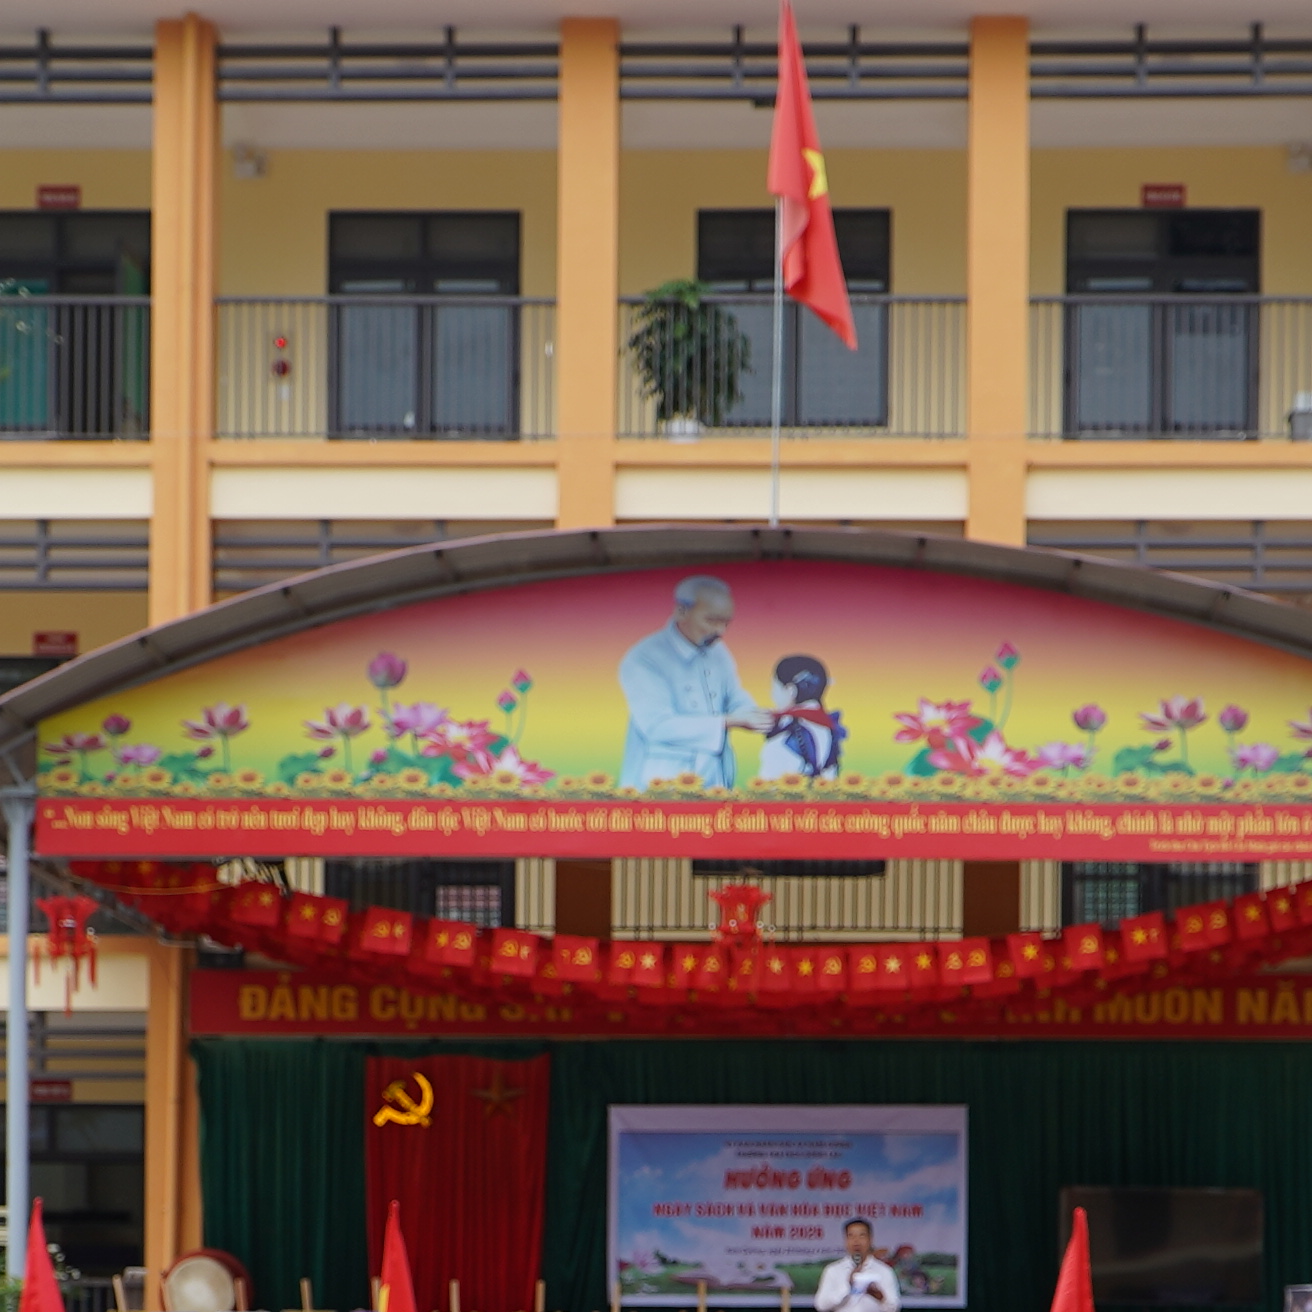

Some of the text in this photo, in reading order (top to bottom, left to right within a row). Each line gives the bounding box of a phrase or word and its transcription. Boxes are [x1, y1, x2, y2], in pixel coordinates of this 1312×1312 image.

[129, 804, 160, 835] Việt
[161, 804, 196, 829] Nam
[329, 805, 354, 836] hay
[408, 805, 436, 830] dân
[461, 805, 491, 836] Việt
[492, 806, 528, 831] Nam
[667, 813, 714, 838] quang
[734, 807, 768, 832] sánh
[819, 807, 844, 833] các
[928, 810, 961, 834] năm
[1037, 809, 1063, 840] hay
[239, 973, 359, 1021] ĐẢNG
[723, 1162, 852, 1189] HƯỞNG ỨNG
[855, 1201, 886, 1219] VIỆT
[889, 1202, 924, 1218] NAM
